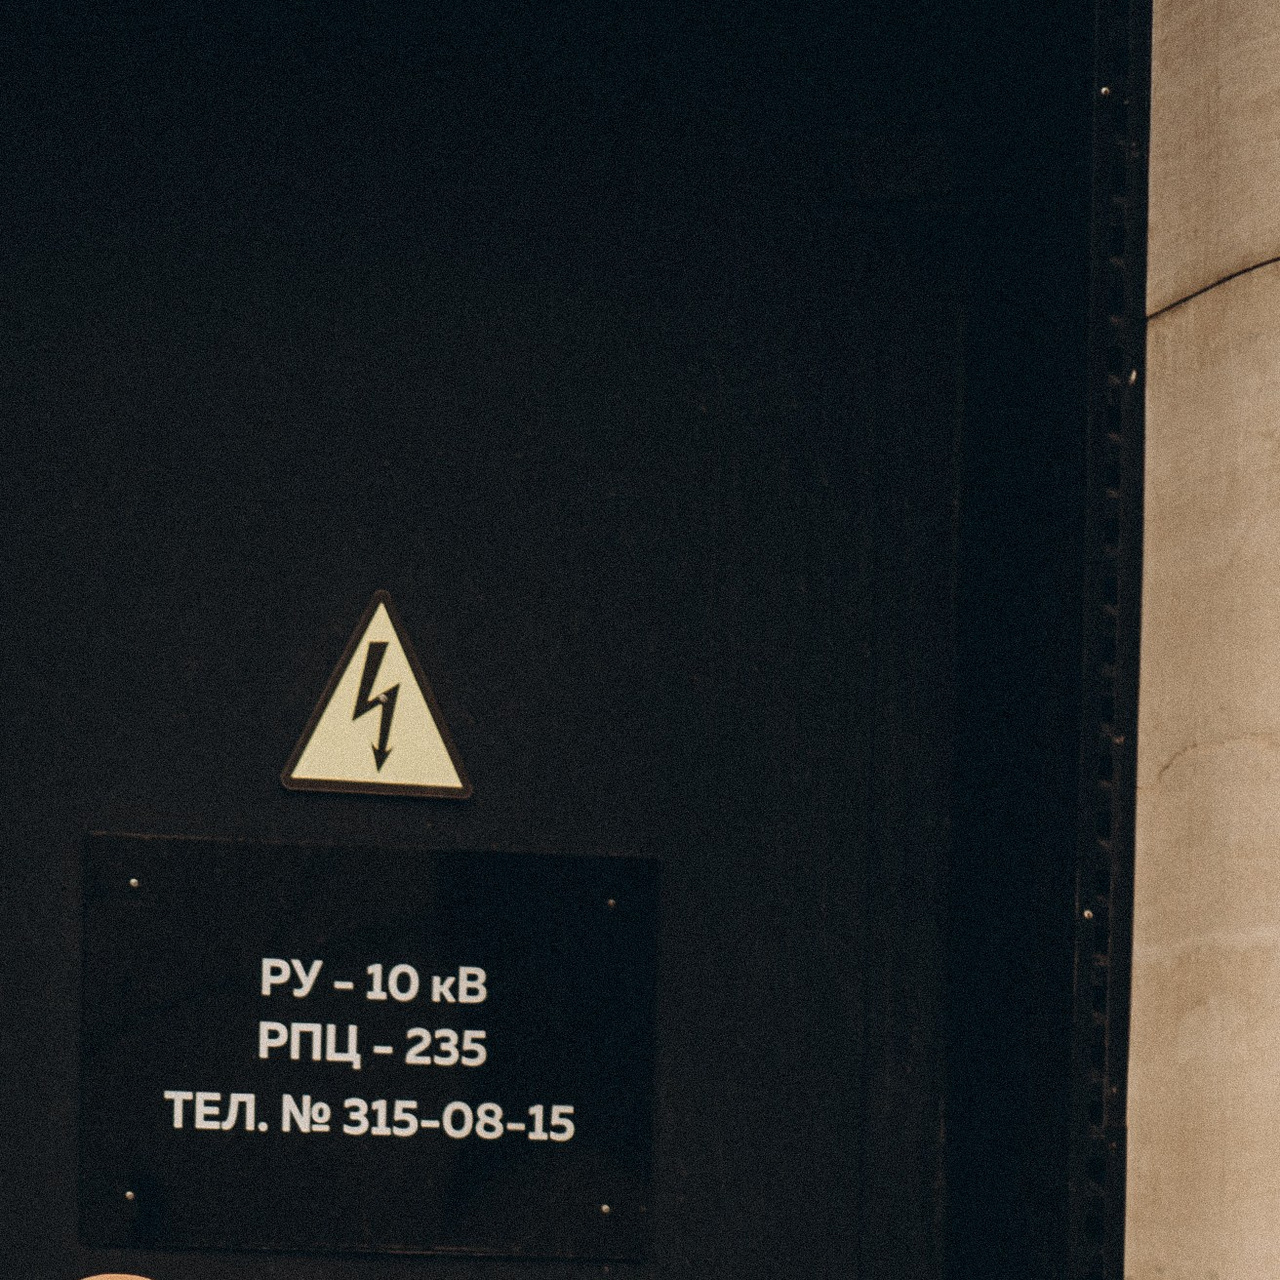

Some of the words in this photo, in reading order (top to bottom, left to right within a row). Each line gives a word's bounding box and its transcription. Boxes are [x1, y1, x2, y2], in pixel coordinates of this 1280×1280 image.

[261, 957, 324, 998] РУ
[366, 963, 420, 1003] 10
[430, 965, 488, 1004] кВ
[258, 1020, 362, 1071] РПЦ
[404, 1026, 487, 1067] 235
[163, 1090, 269, 1132] ТЕЛ.
[281, 1093, 332, 1134] №
[342, 1097, 575, 1142] 315-08-15
